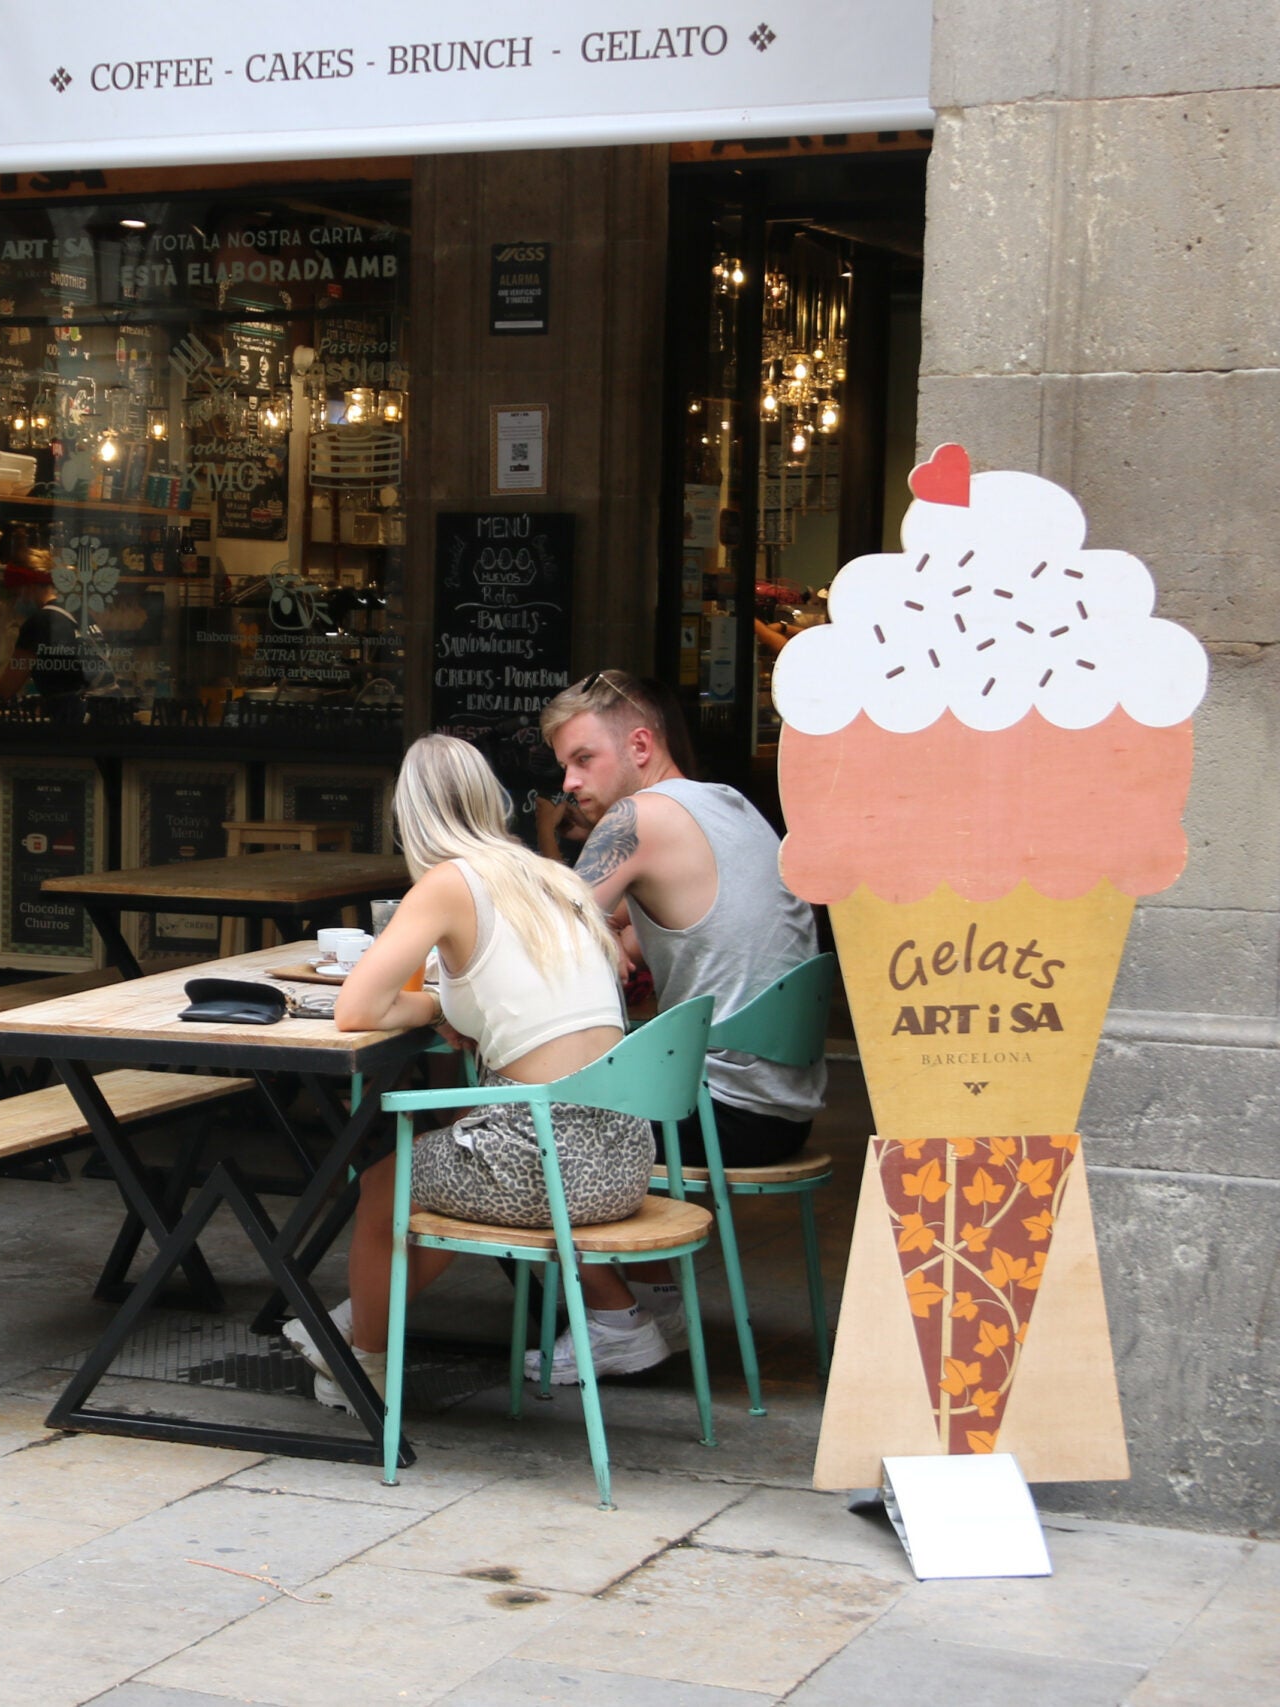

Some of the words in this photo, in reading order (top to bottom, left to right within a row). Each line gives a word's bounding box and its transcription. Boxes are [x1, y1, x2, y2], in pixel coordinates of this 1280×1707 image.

[90, 57, 213, 92] COFFEE
[245, 49, 354, 83] CAKES
[387, 36, 533, 75] BRUNCH
[580, 24, 728, 63] GELATO
[152, 233, 196, 251] TOTA
[203, 232, 220, 250] LA
[228, 228, 302, 248] NOSTRA
[309, 226, 363, 246] CARTA
[120, 258, 178, 287] ESTÀ
[187, 256, 334, 285] ELABORADA
[344, 254, 398, 280] AMB
[500, 273, 540, 287] ALARMA
[320, 337, 398, 354] Pastissos
[477, 513, 530, 538] MENÚ
[482, 572, 521, 583] HUEVOS
[265, 633, 303, 645] nostres
[362, 635, 385, 646] amb
[388, 636, 402, 646] oli
[37, 643, 76, 656] Fruites
[254, 648, 296, 662] EXTRA
[299, 649, 343, 663] VERGE
[10, 658, 26, 670] DE
[114, 660, 164, 672] LOCALS
[27, 809, 68, 823] Special
[166, 814, 210, 828] Today's
[171, 826, 203, 840] Menu
[19, 901, 76, 916] Chocolate
[24, 916, 70, 931] Churros
[888, 922, 1066, 991] Gelats
[921, 1051, 1033, 1065] BARCELONA
